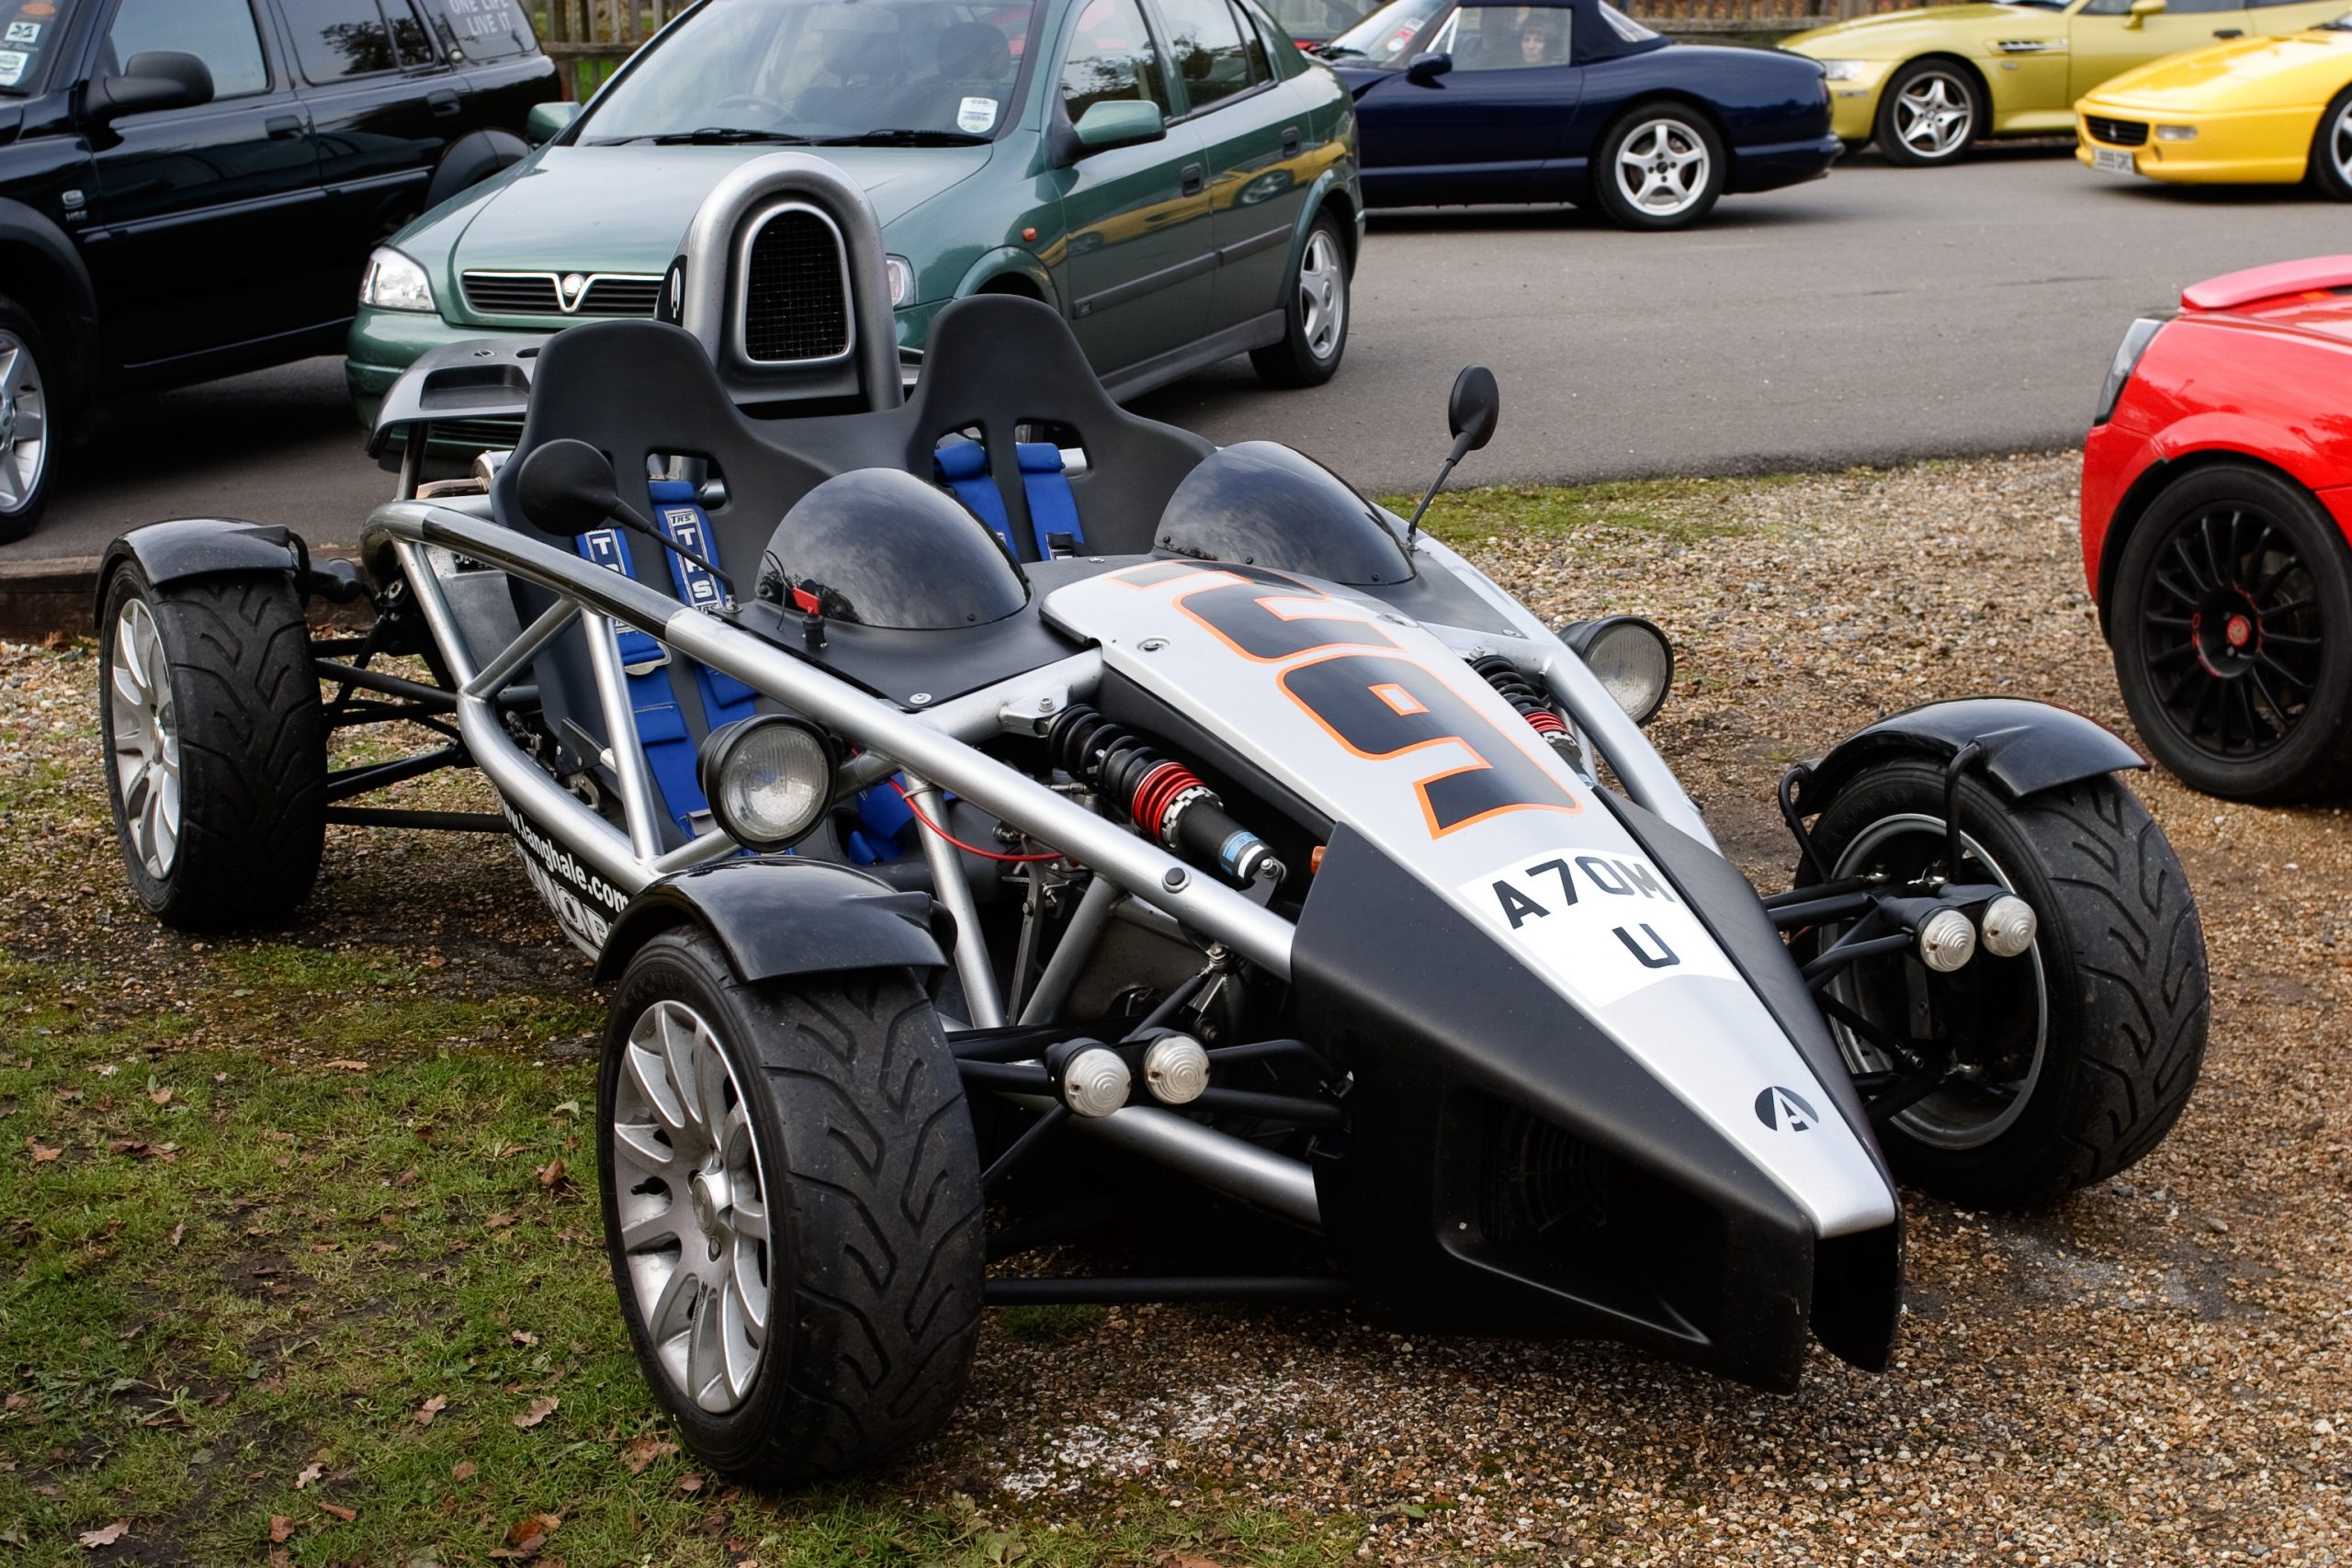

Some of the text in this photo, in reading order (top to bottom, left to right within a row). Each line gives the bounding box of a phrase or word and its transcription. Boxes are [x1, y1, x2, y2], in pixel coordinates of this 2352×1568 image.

[449, 0, 479, 15] ONE
[466, 11, 512, 36] LIVE IT
[1611, 923, 1680, 969] U
